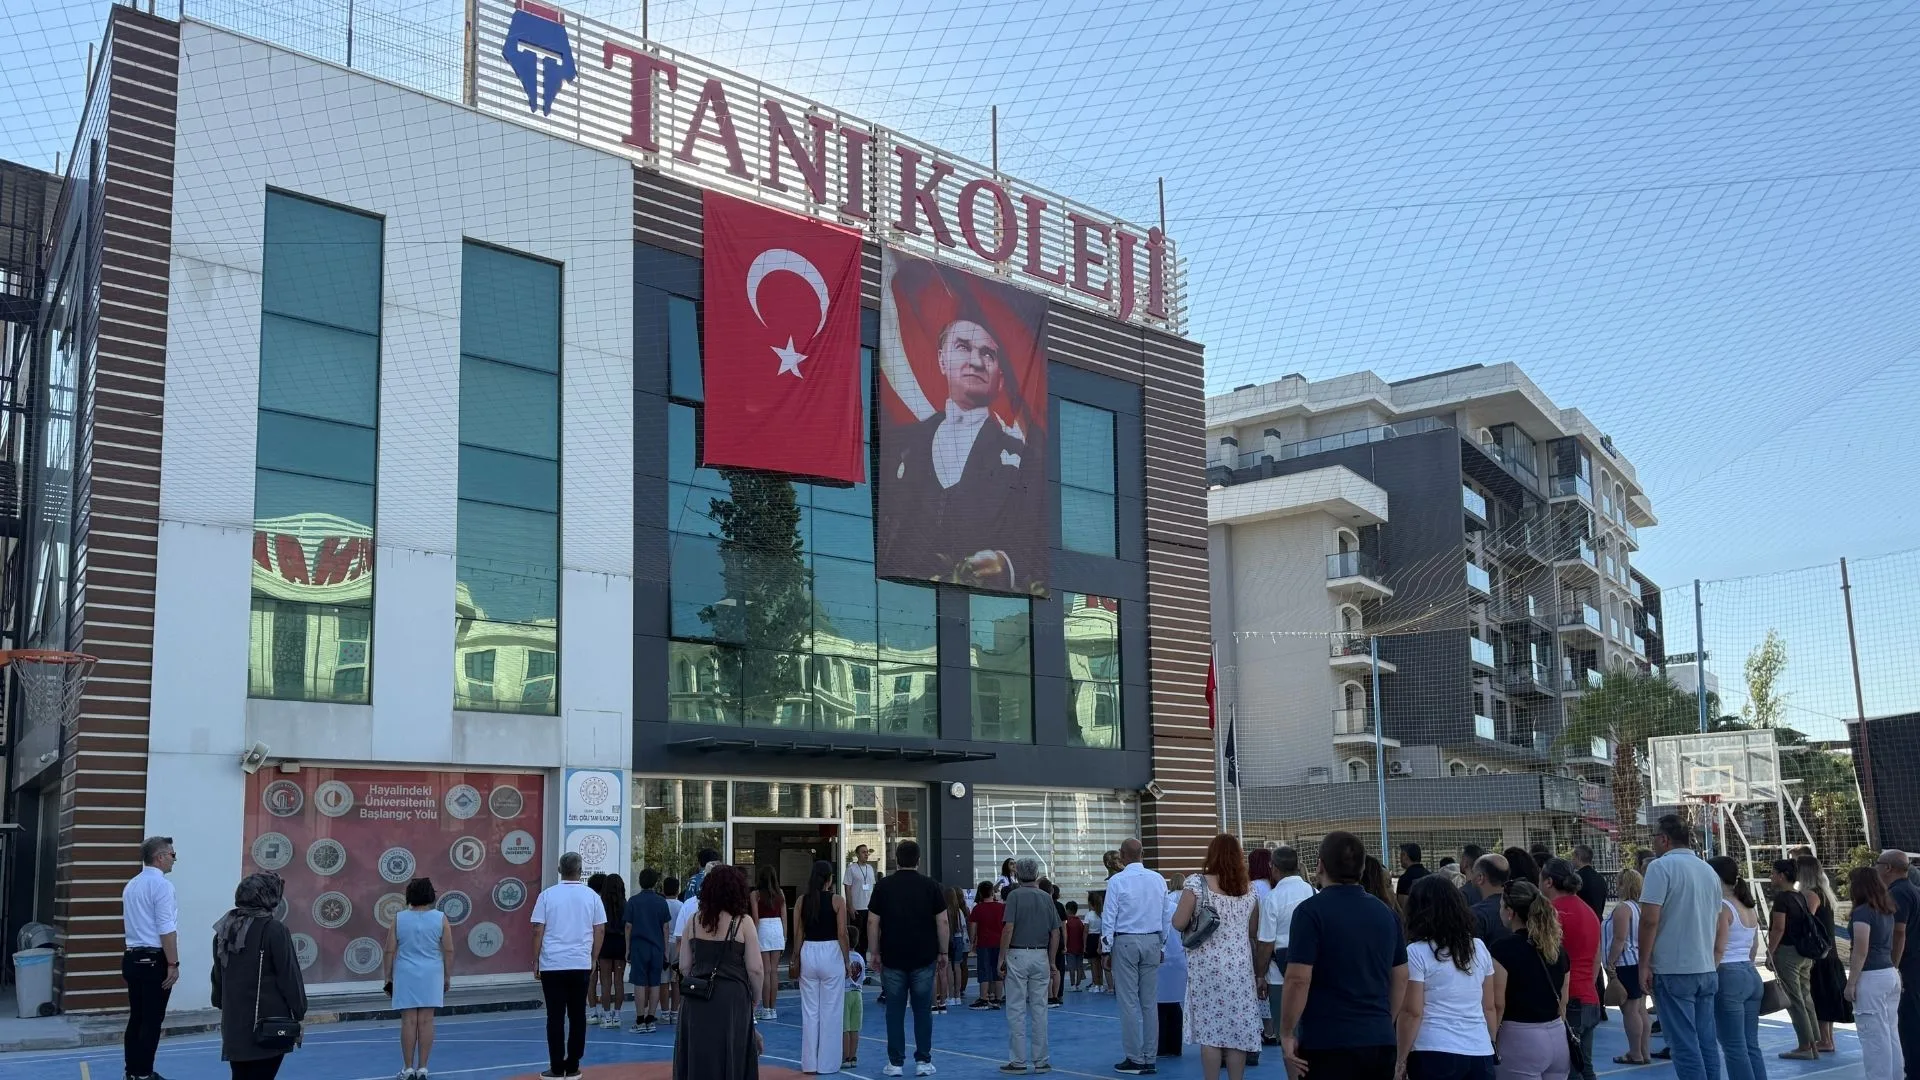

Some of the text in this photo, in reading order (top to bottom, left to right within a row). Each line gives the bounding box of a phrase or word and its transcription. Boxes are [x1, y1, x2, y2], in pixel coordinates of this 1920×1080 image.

[602, 40, 873, 221] TANI
[369, 784, 432, 796] Hayalindeki
[365, 794, 435, 807] Üniversitenin
[360, 808, 438, 820] Başlangıç Yolu
